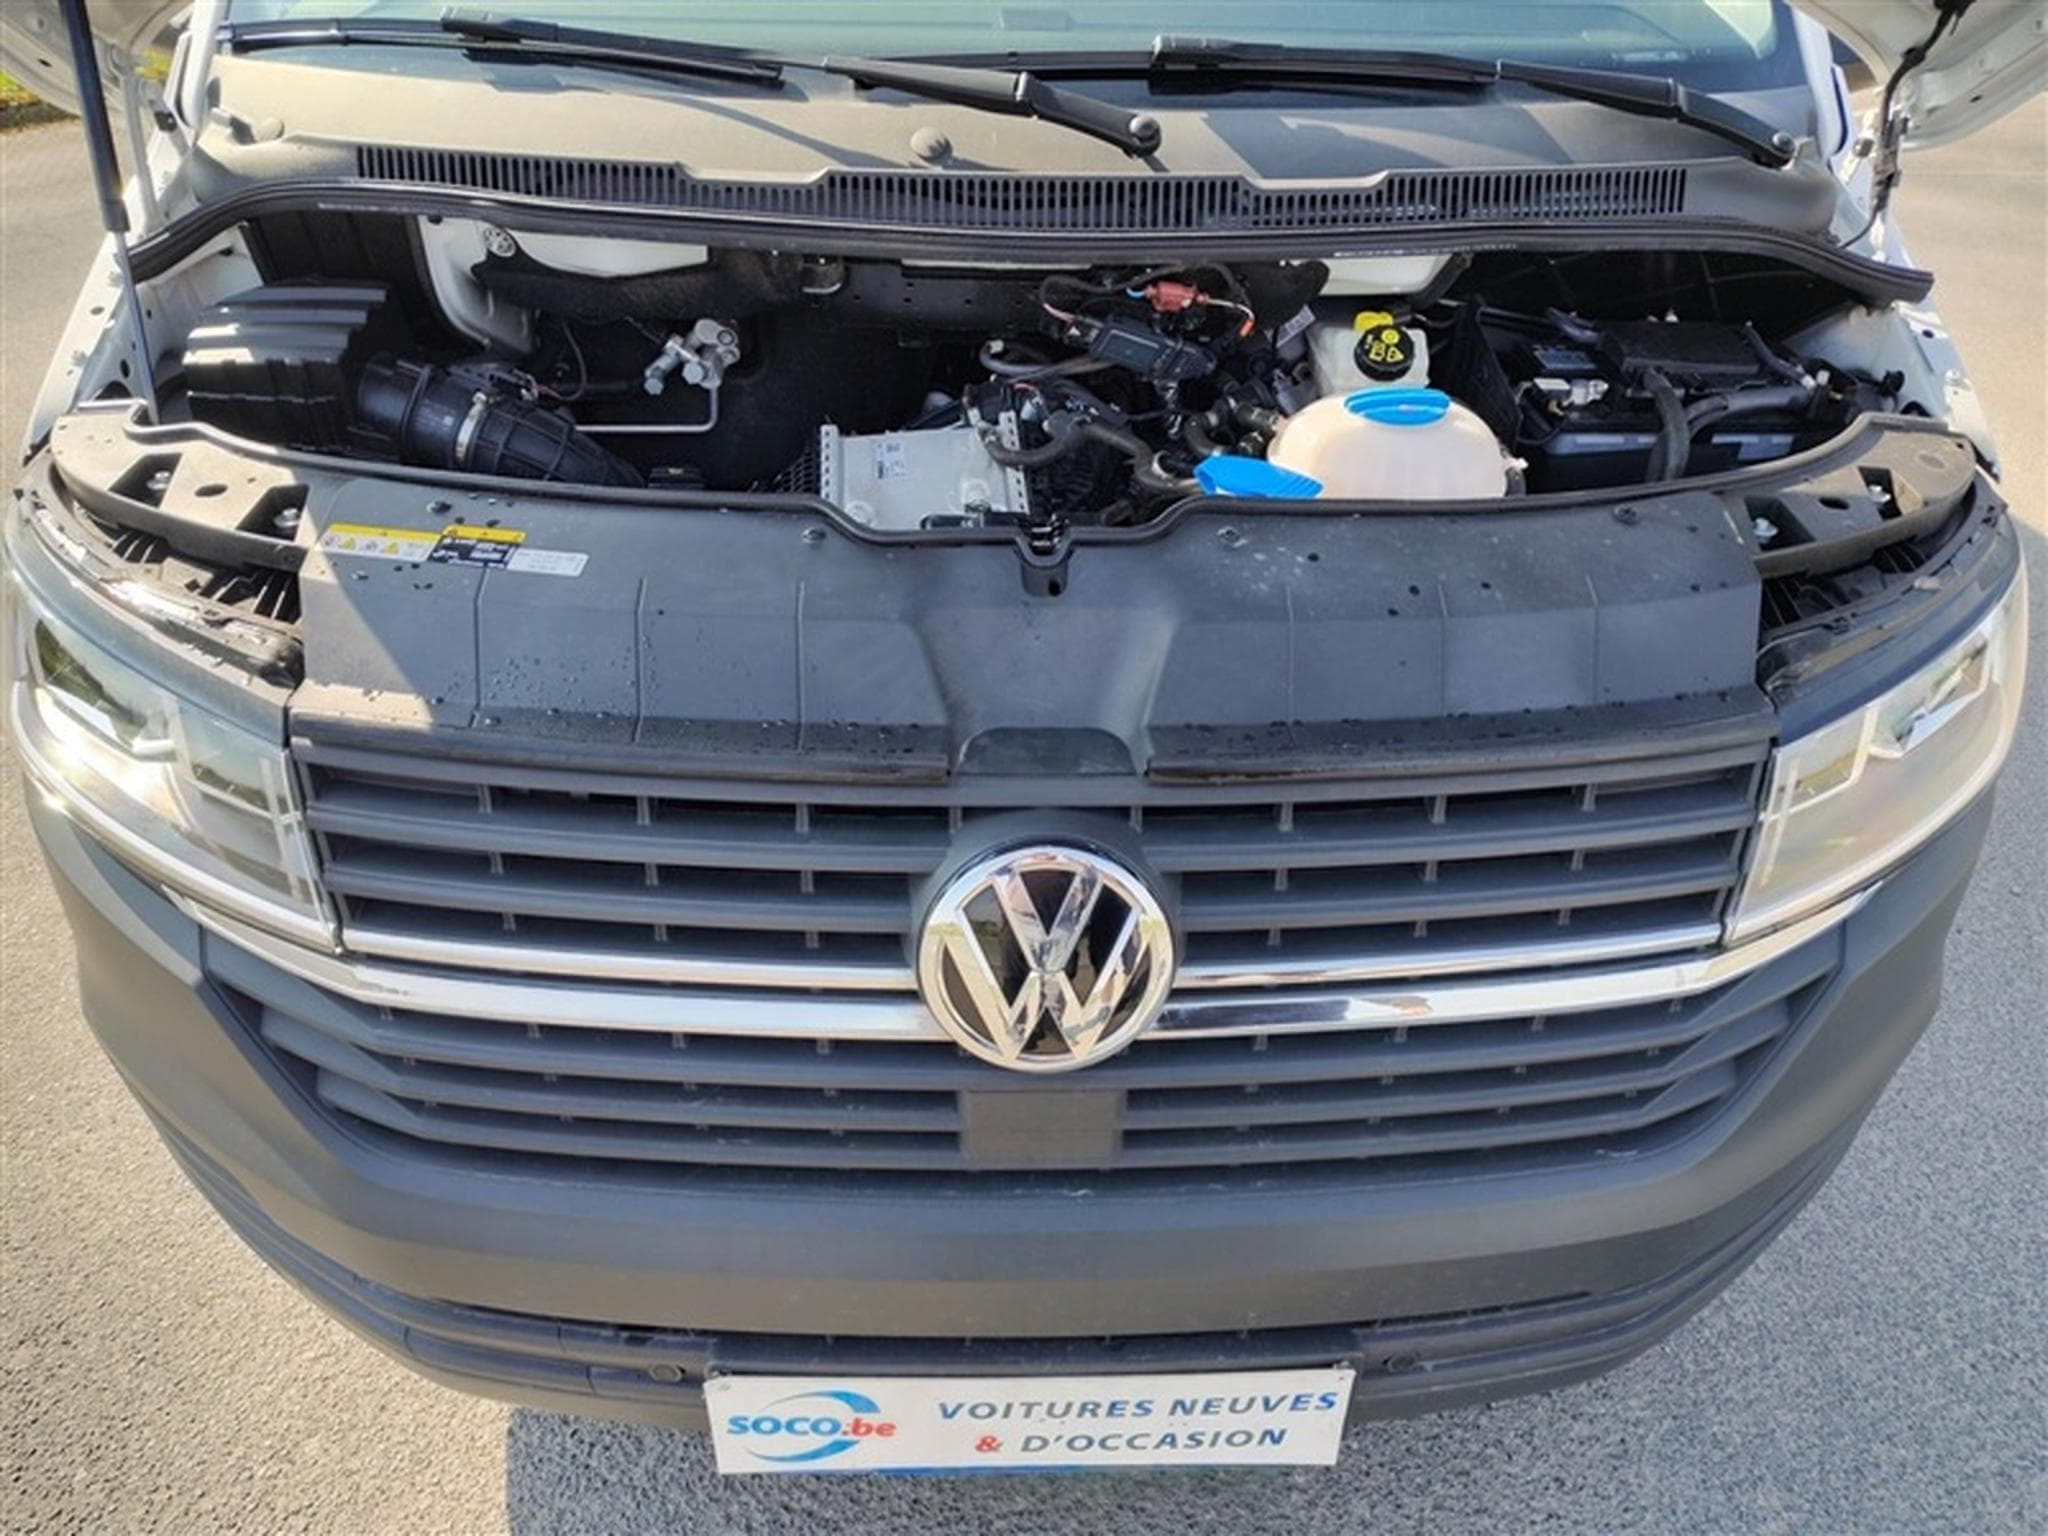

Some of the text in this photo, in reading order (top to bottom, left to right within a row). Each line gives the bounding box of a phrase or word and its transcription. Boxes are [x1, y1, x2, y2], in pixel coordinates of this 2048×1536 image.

[929, 858, 1160, 1065] VW
[938, 1391, 1339, 1421] VOITURES NEUVES
[975, 1428, 1288, 1453] & D'OCCASION
